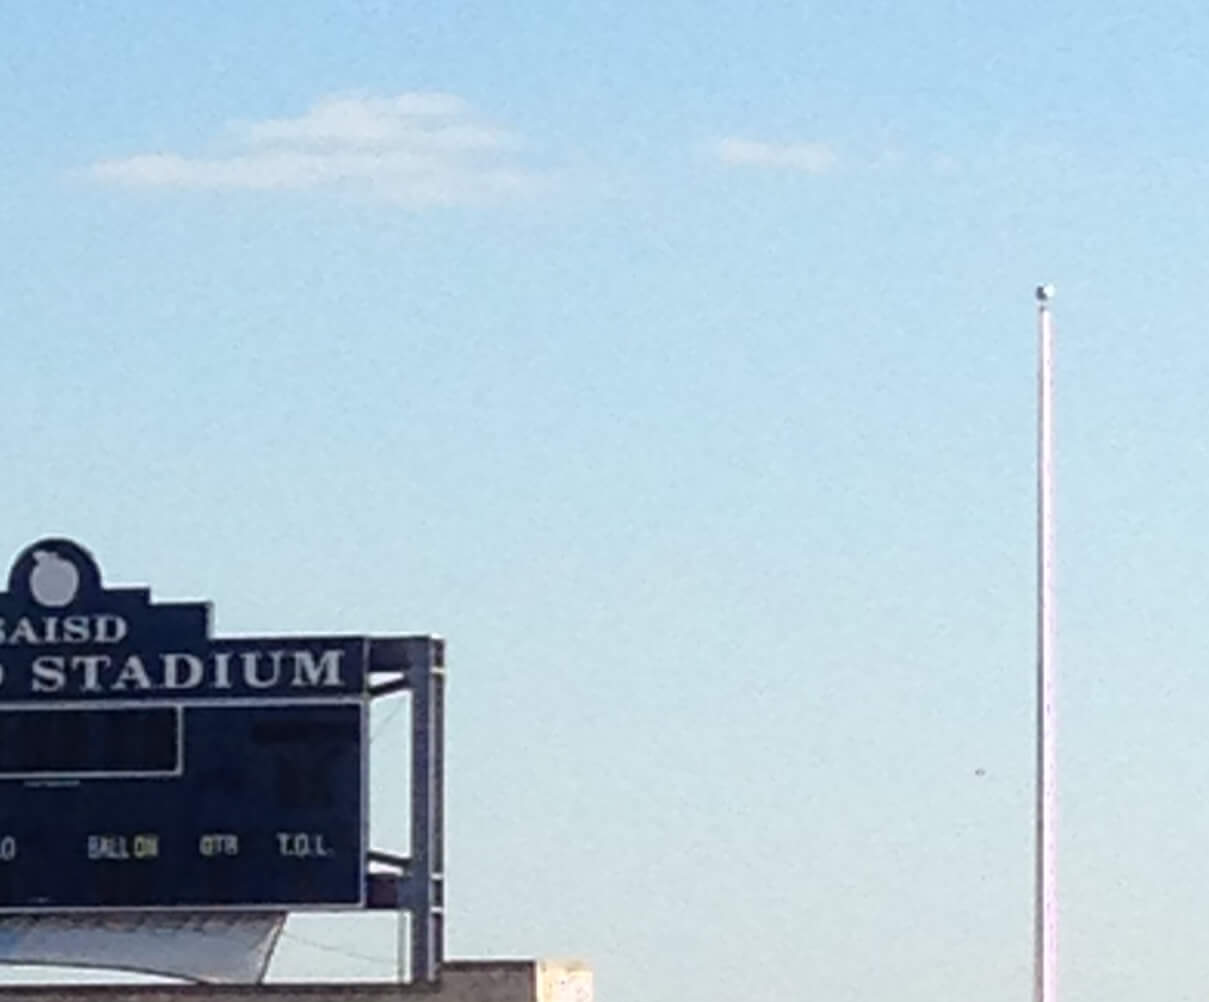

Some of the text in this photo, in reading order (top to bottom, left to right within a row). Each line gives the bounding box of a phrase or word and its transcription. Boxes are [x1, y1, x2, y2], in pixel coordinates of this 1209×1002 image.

[31, 648, 346, 692] STADIUM
[88, 835, 158, 859] BALL ON
